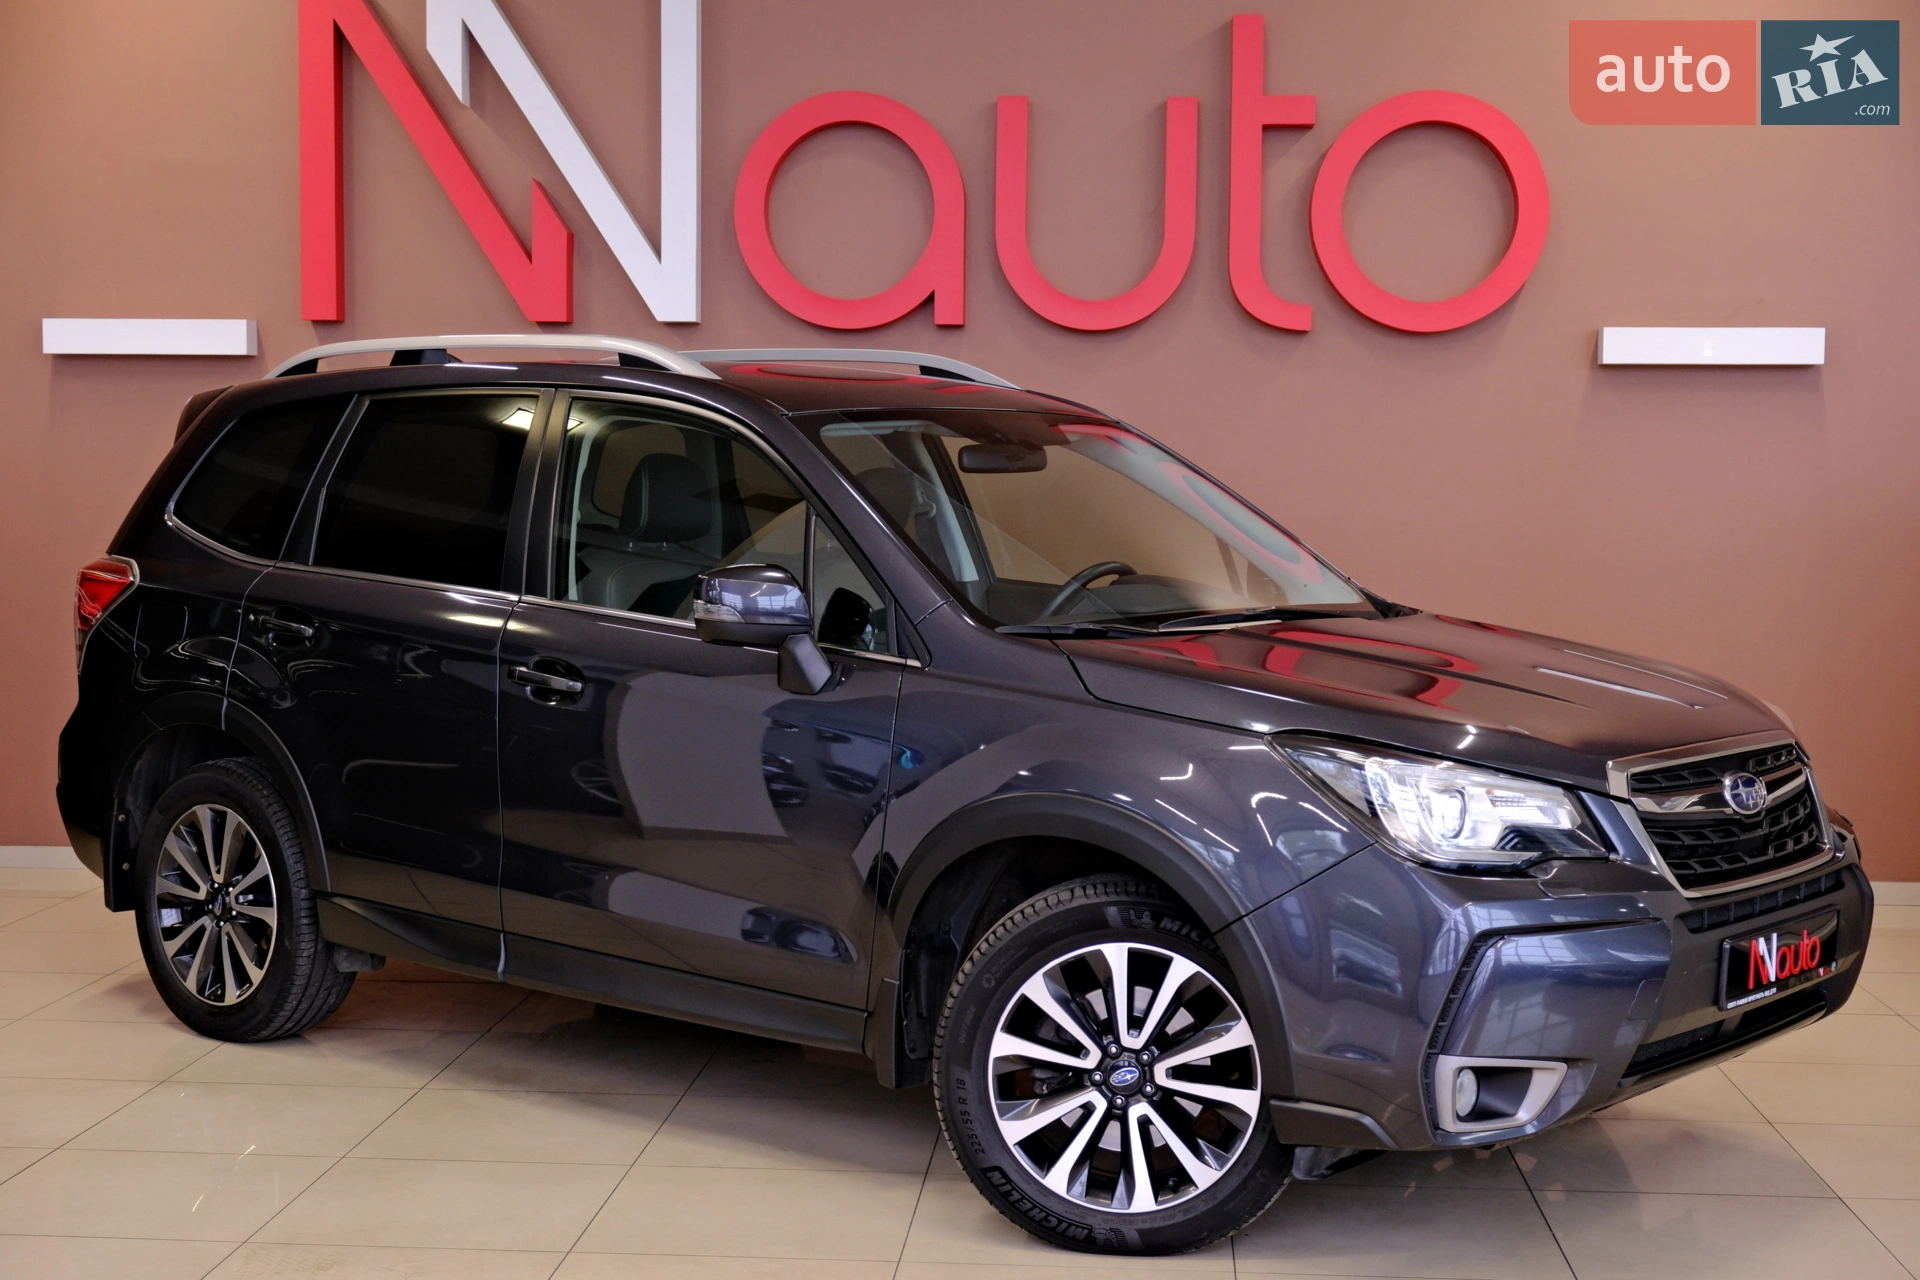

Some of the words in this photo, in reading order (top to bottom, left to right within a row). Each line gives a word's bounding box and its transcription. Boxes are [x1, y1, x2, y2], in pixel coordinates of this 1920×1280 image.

[958, 1004, 977, 1045] OUTSIDE
[956, 1078, 966, 1091] 18
[958, 1096, 969, 1106] R
[960, 1109, 986, 1155] 225/55
[985, 1170, 1090, 1241] MICHELIN
